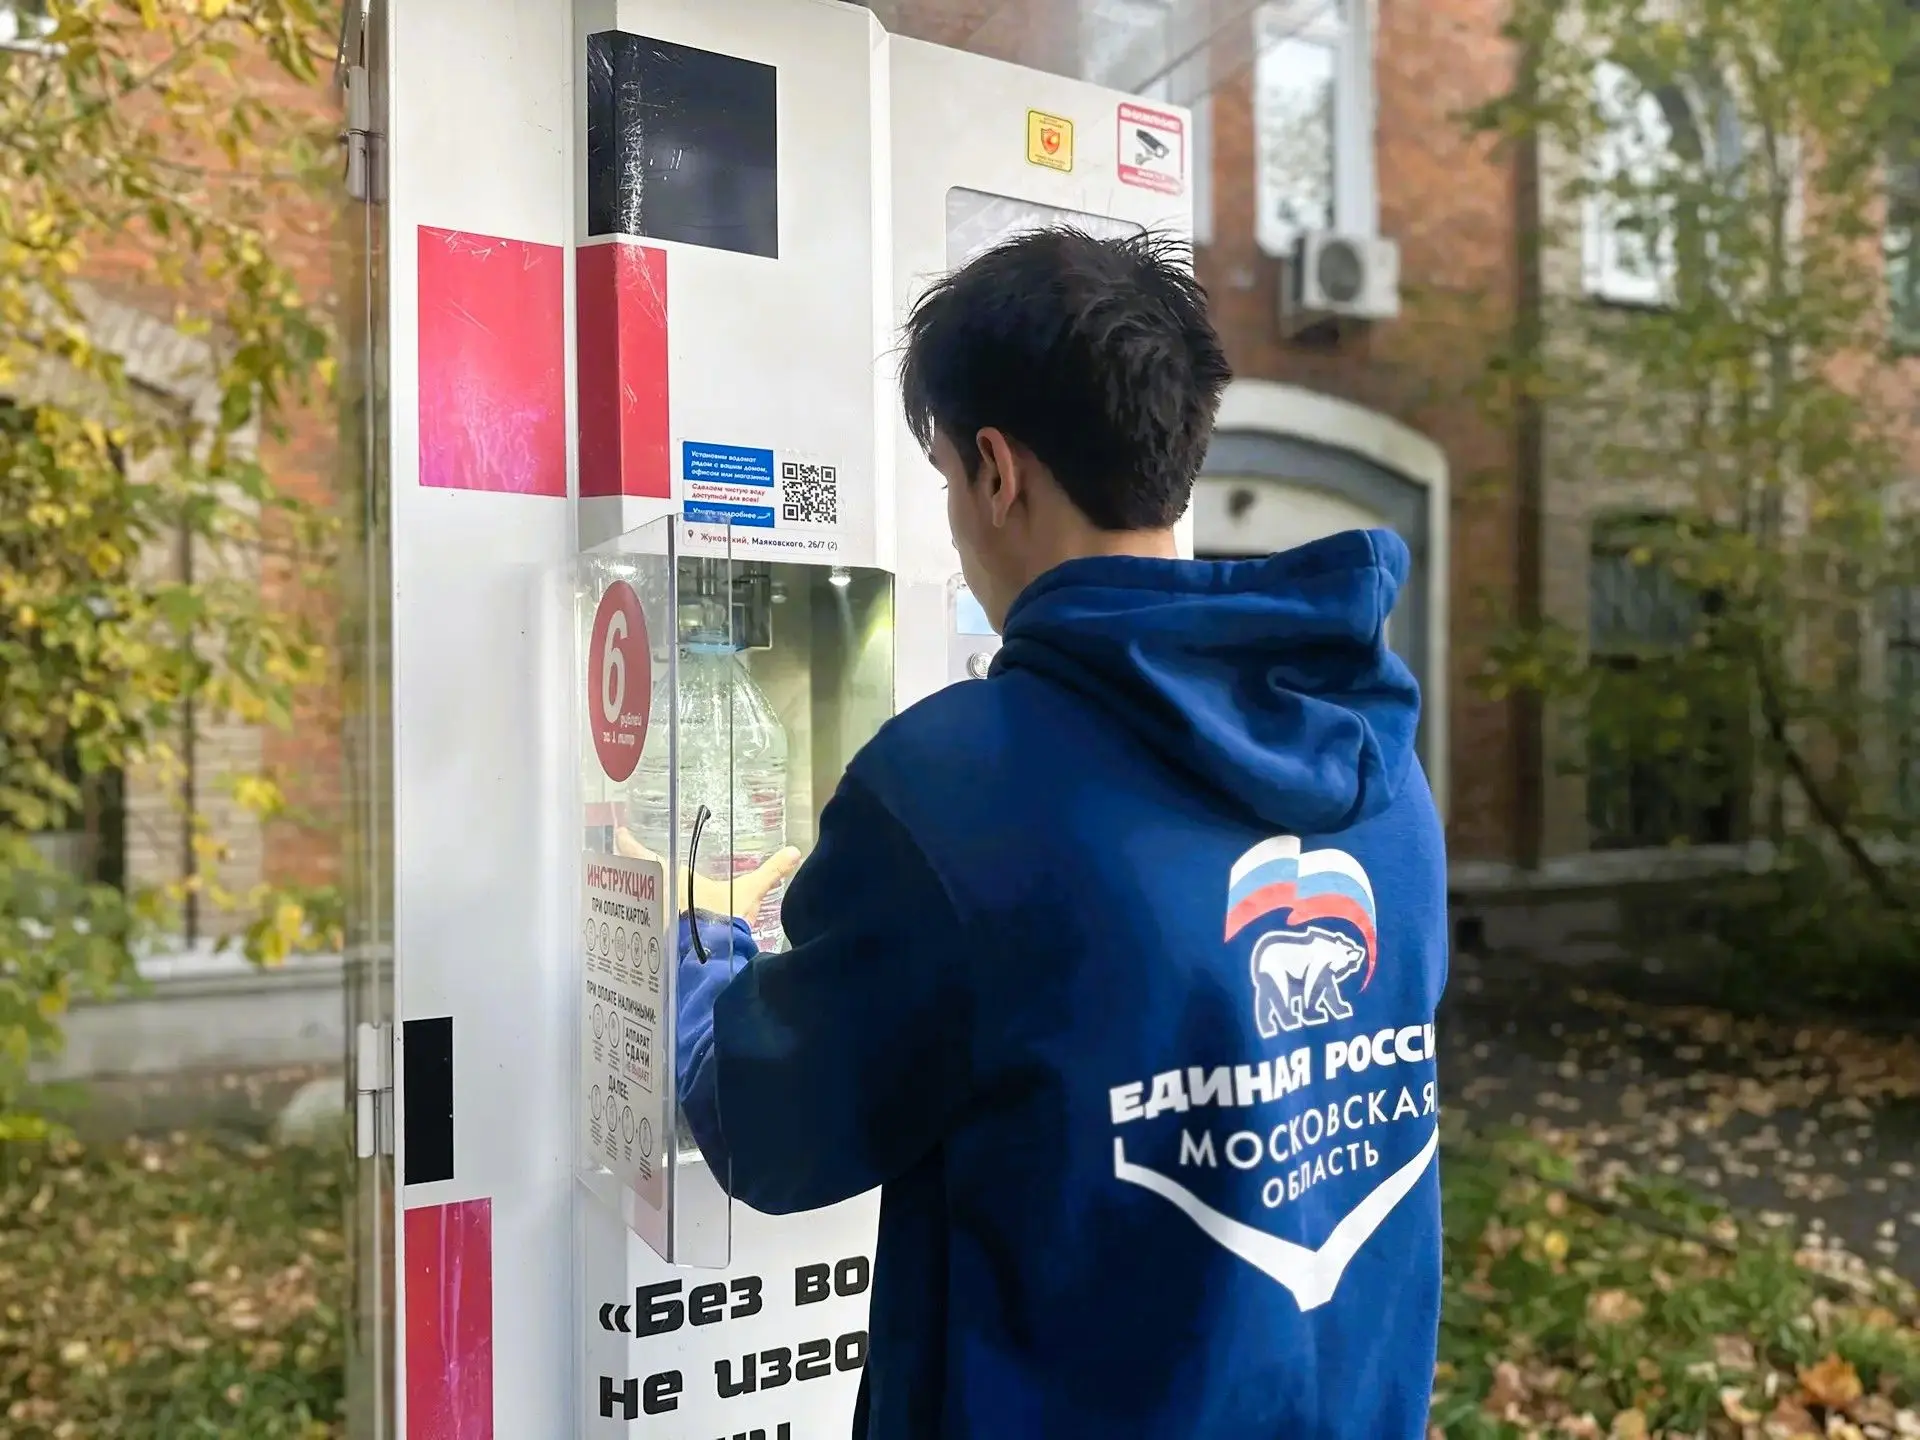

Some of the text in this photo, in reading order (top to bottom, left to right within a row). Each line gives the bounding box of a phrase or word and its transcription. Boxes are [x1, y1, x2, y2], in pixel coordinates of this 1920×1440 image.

[729, 455, 756, 463] водомат
[691, 468, 720, 477] офисом
[734, 473, 771, 481] магазином
[692, 483, 723, 491] Сделаем
[725, 487, 748, 495] чистую
[692, 492, 727, 500] доступной
[700, 533, 838, 551] Жуковкий, Маяковского, 26/7 (2)
[602, 609, 629, 724] 6
[611, 730, 617, 744] 1
[586, 863, 655, 902] ИНСТРУКЦИЯ
[591, 897, 603, 913] ПРИ
[603, 900, 625, 920] ОПЛАТЕ
[586, 980, 597, 997] ПРИ
[597, 984, 617, 1006] ОПЛАТЕ
[626, 1027, 650, 1050] АППАРАТ
[625, 1042, 650, 1068] СДАЧИ
[1109, 1046, 1311, 1125] ЕДИНАЯ
[1179, 1080, 1436, 1169] МОСКОВСКАЯ
[1262, 1140, 1379, 1209] ОБЛАСТЬ
[598, 1275, 763, 1338] «Без
[599, 1369, 683, 1421] не
